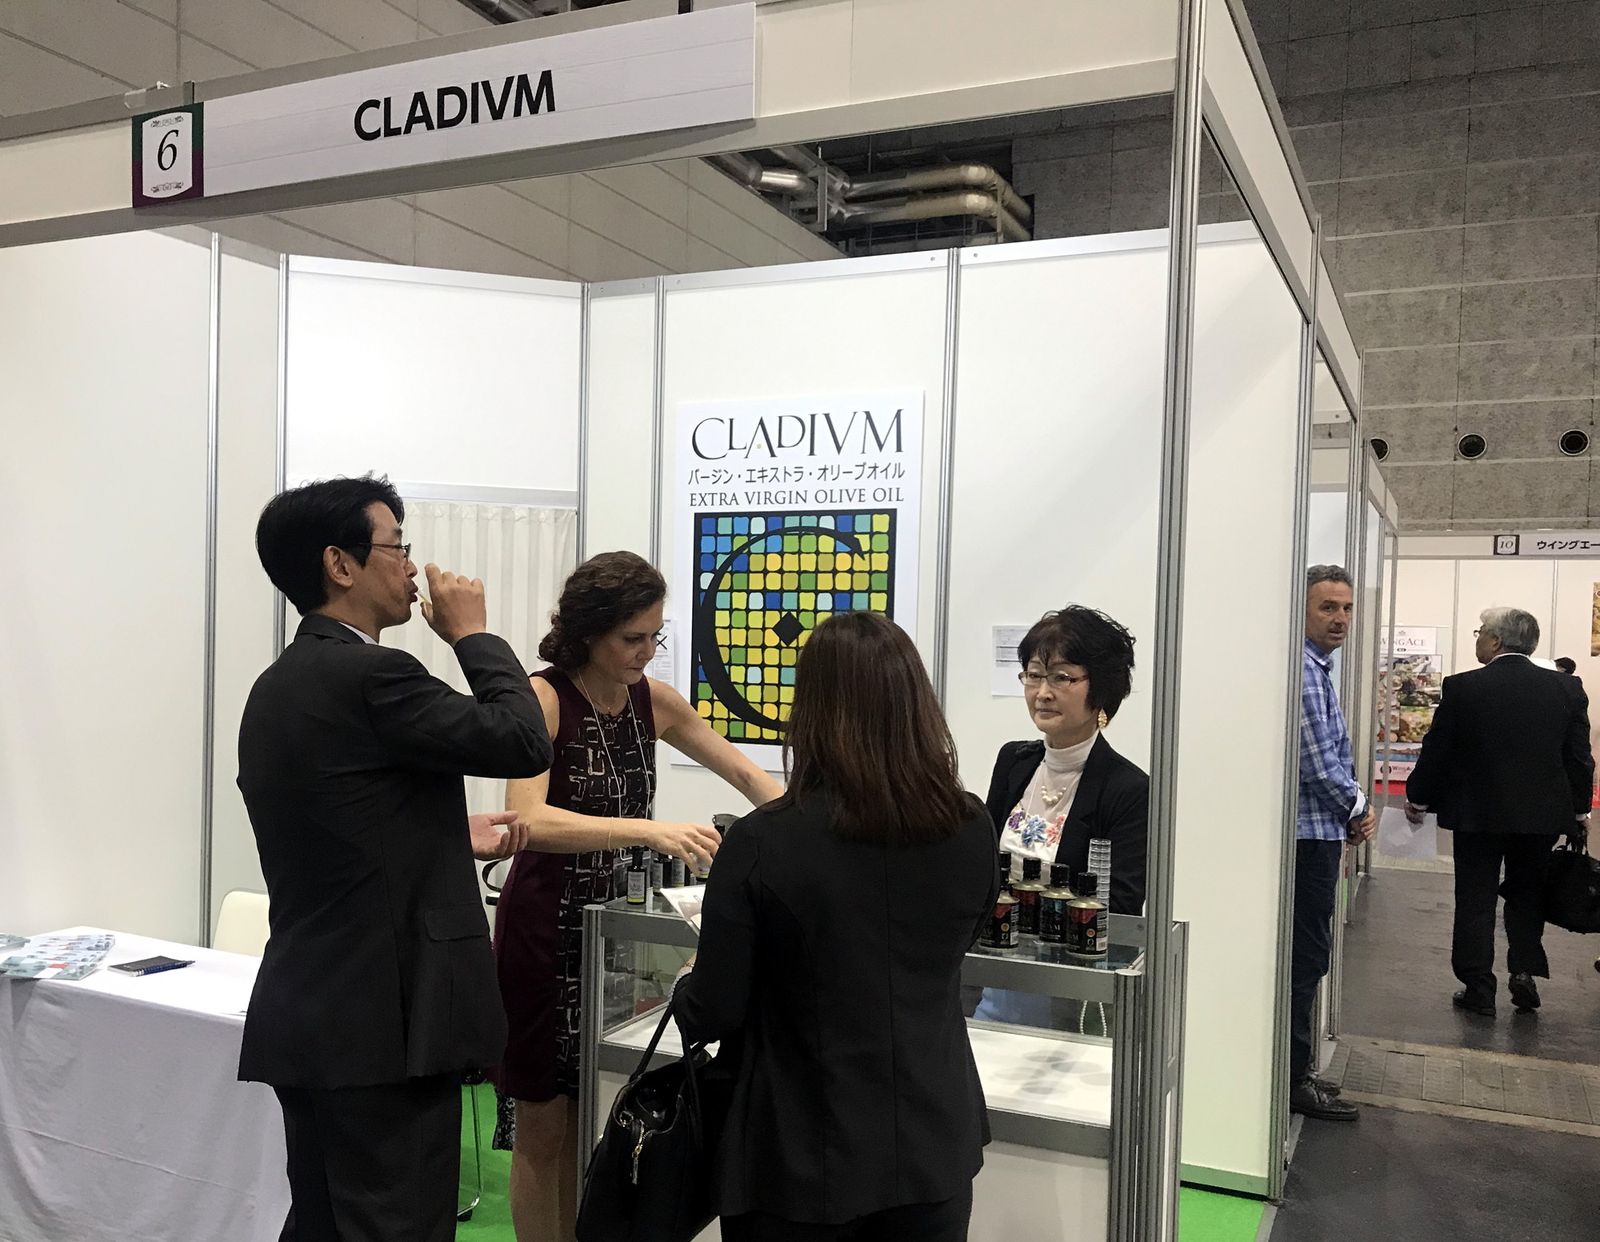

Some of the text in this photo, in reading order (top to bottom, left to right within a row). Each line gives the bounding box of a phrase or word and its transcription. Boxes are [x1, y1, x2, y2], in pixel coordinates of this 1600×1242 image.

[354, 69, 556, 141] CLADIVM
[157, 129, 179, 171] 6
[691, 408, 904, 460] CLADIVM
[689, 487, 904, 507] EXTRA VIRGIN OLIVE OIL
[1500, 540, 1514, 549] 10
